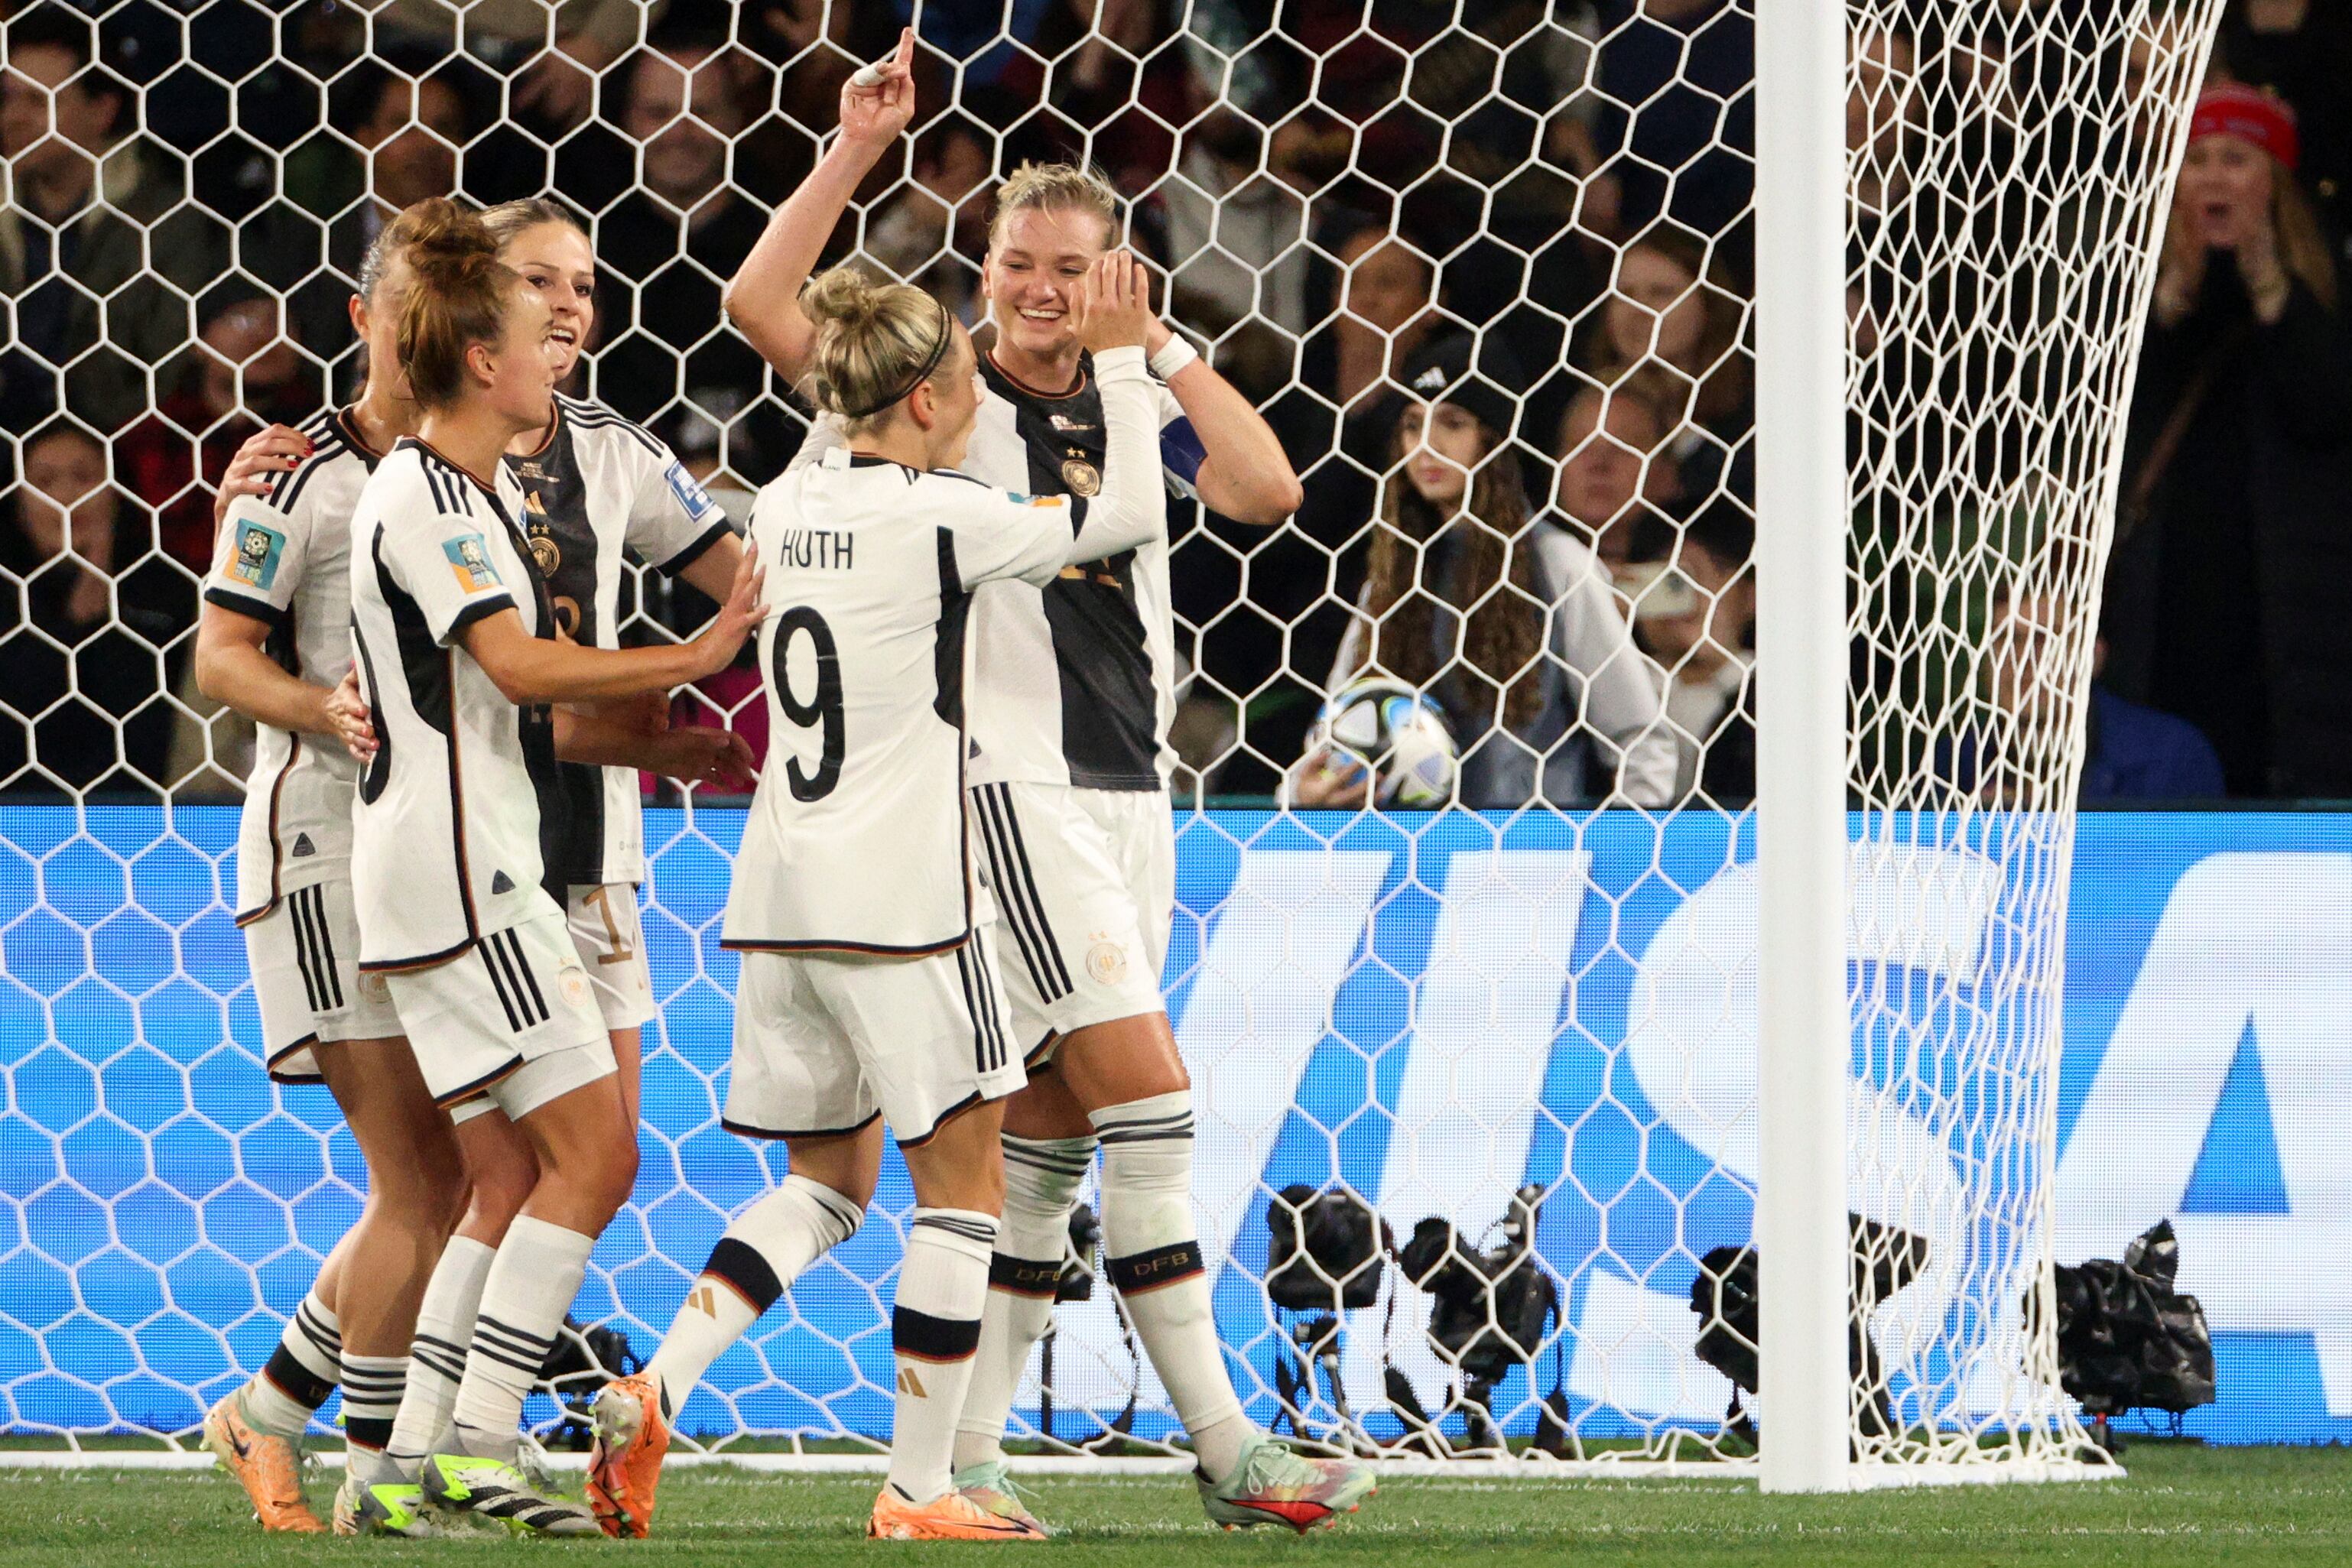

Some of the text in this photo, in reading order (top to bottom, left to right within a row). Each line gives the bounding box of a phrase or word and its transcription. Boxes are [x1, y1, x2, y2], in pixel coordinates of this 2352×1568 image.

[781, 529, 853, 569] HUTH
[773, 605, 846, 803] 9
[1133, 1251, 1190, 1277] DFB
